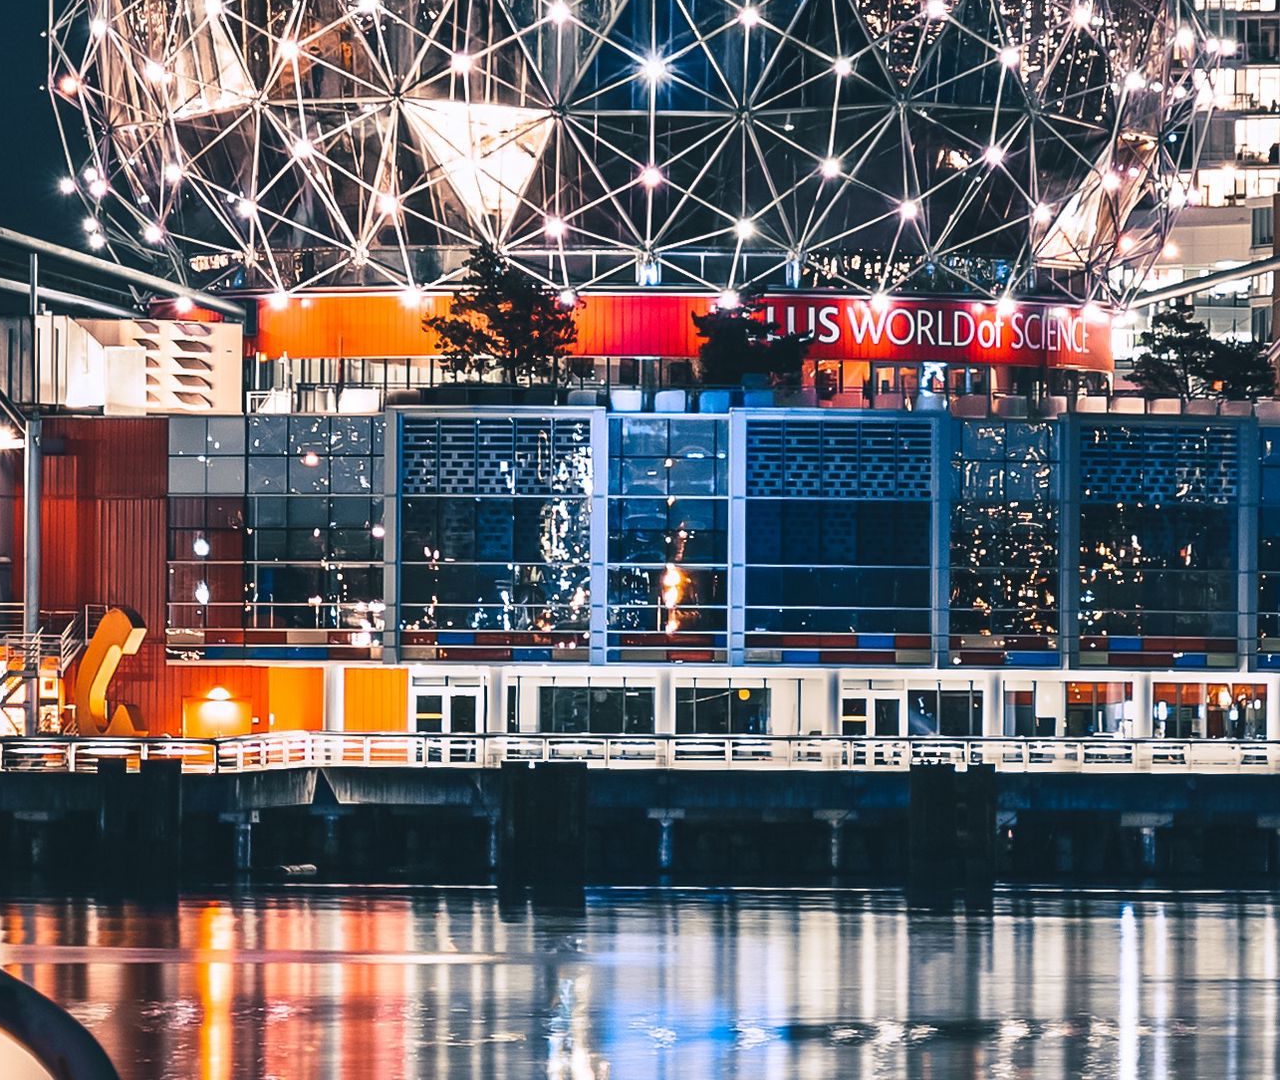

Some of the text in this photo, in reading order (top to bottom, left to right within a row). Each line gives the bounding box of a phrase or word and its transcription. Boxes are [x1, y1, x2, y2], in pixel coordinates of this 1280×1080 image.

[741, 302, 1091, 354] LUS WORLD of SCIENCE
